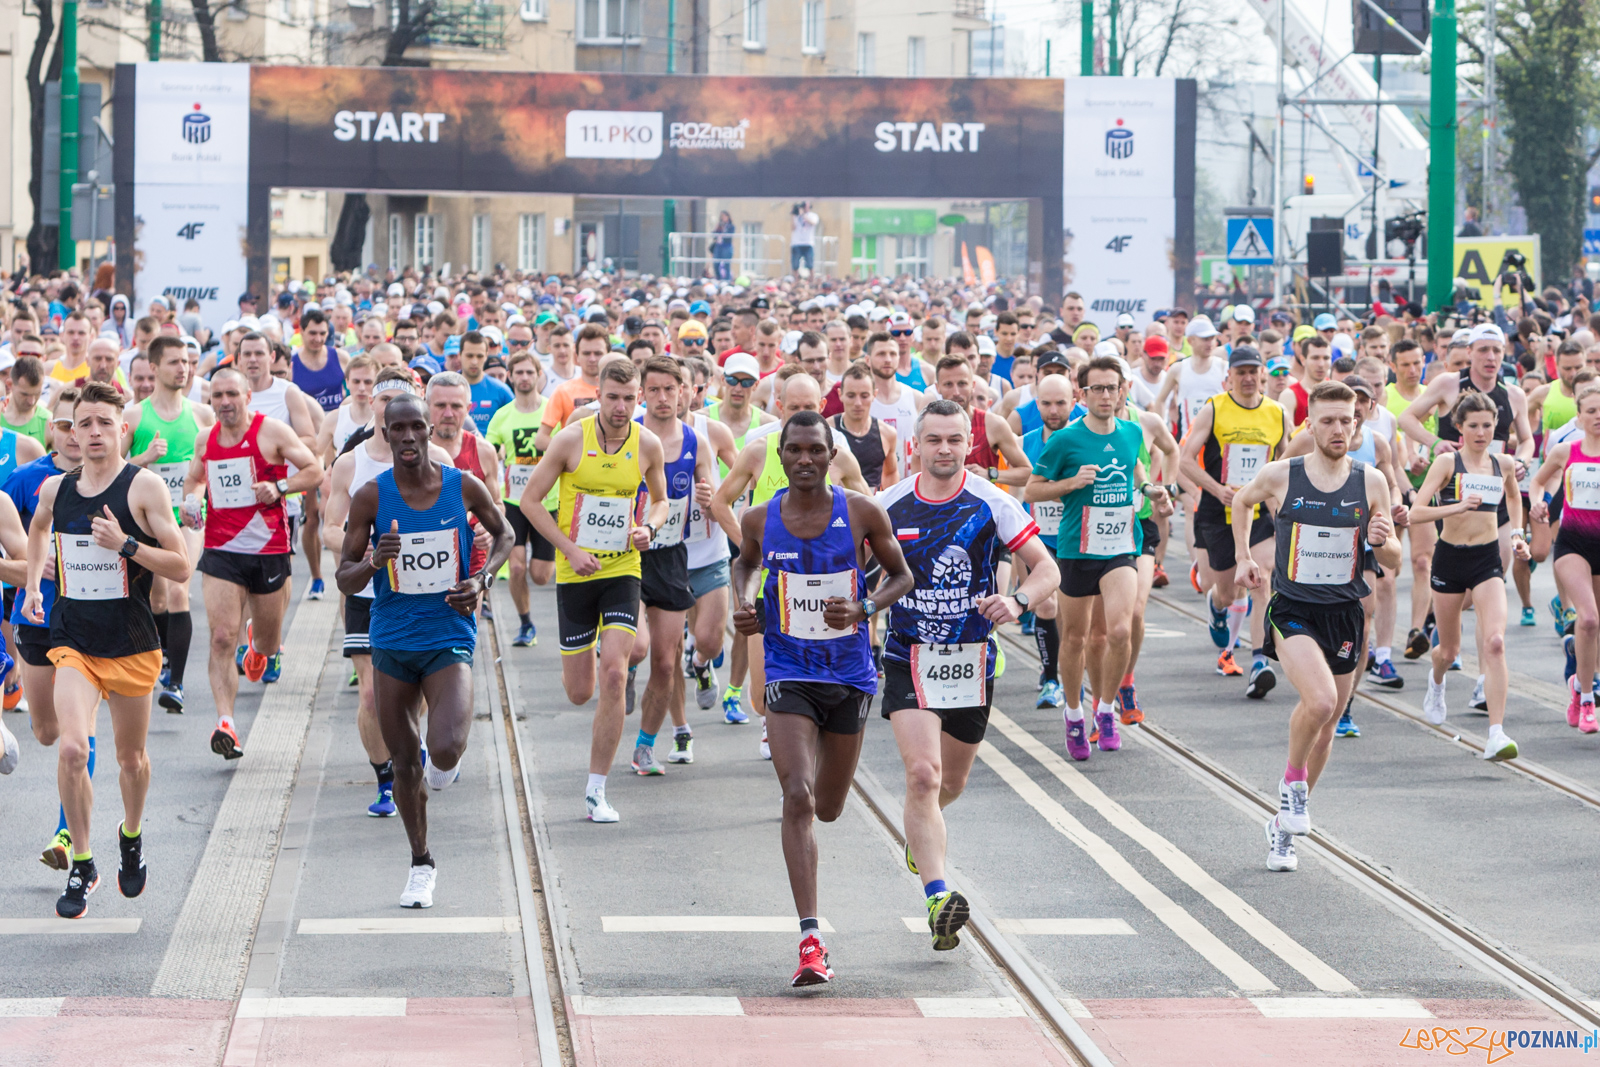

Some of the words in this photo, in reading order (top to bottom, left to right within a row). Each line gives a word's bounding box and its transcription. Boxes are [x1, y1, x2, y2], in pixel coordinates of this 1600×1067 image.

[333, 110, 446, 143] START
[580, 125, 604, 143] 11.
[608, 125, 653, 144] PKO
[873, 121, 986, 153] START
[171, 151, 193, 161] Bank
[195, 151, 222, 162] Polski
[1094, 168, 1116, 177] Bank
[1119, 168, 1144, 177] Polski
[176, 222, 205, 240] 4F
[1105, 235, 1133, 253] 4F
[162, 286, 219, 301] 4MOVE
[1090, 298, 1147, 313] 4MOVE
[1241, 458, 1257, 468] 117
[218, 474, 241, 488] 128
[1093, 493, 1127, 504] GUBIN
[587, 512, 625, 528] 8645
[1096, 522, 1127, 535] 5267
[402, 551, 450, 571] ROP
[1301, 549, 1352, 559] ŚWIERDZEWSKI
[66, 562, 118, 572] CHABOWSKI
[926, 663, 974, 681] 4888
